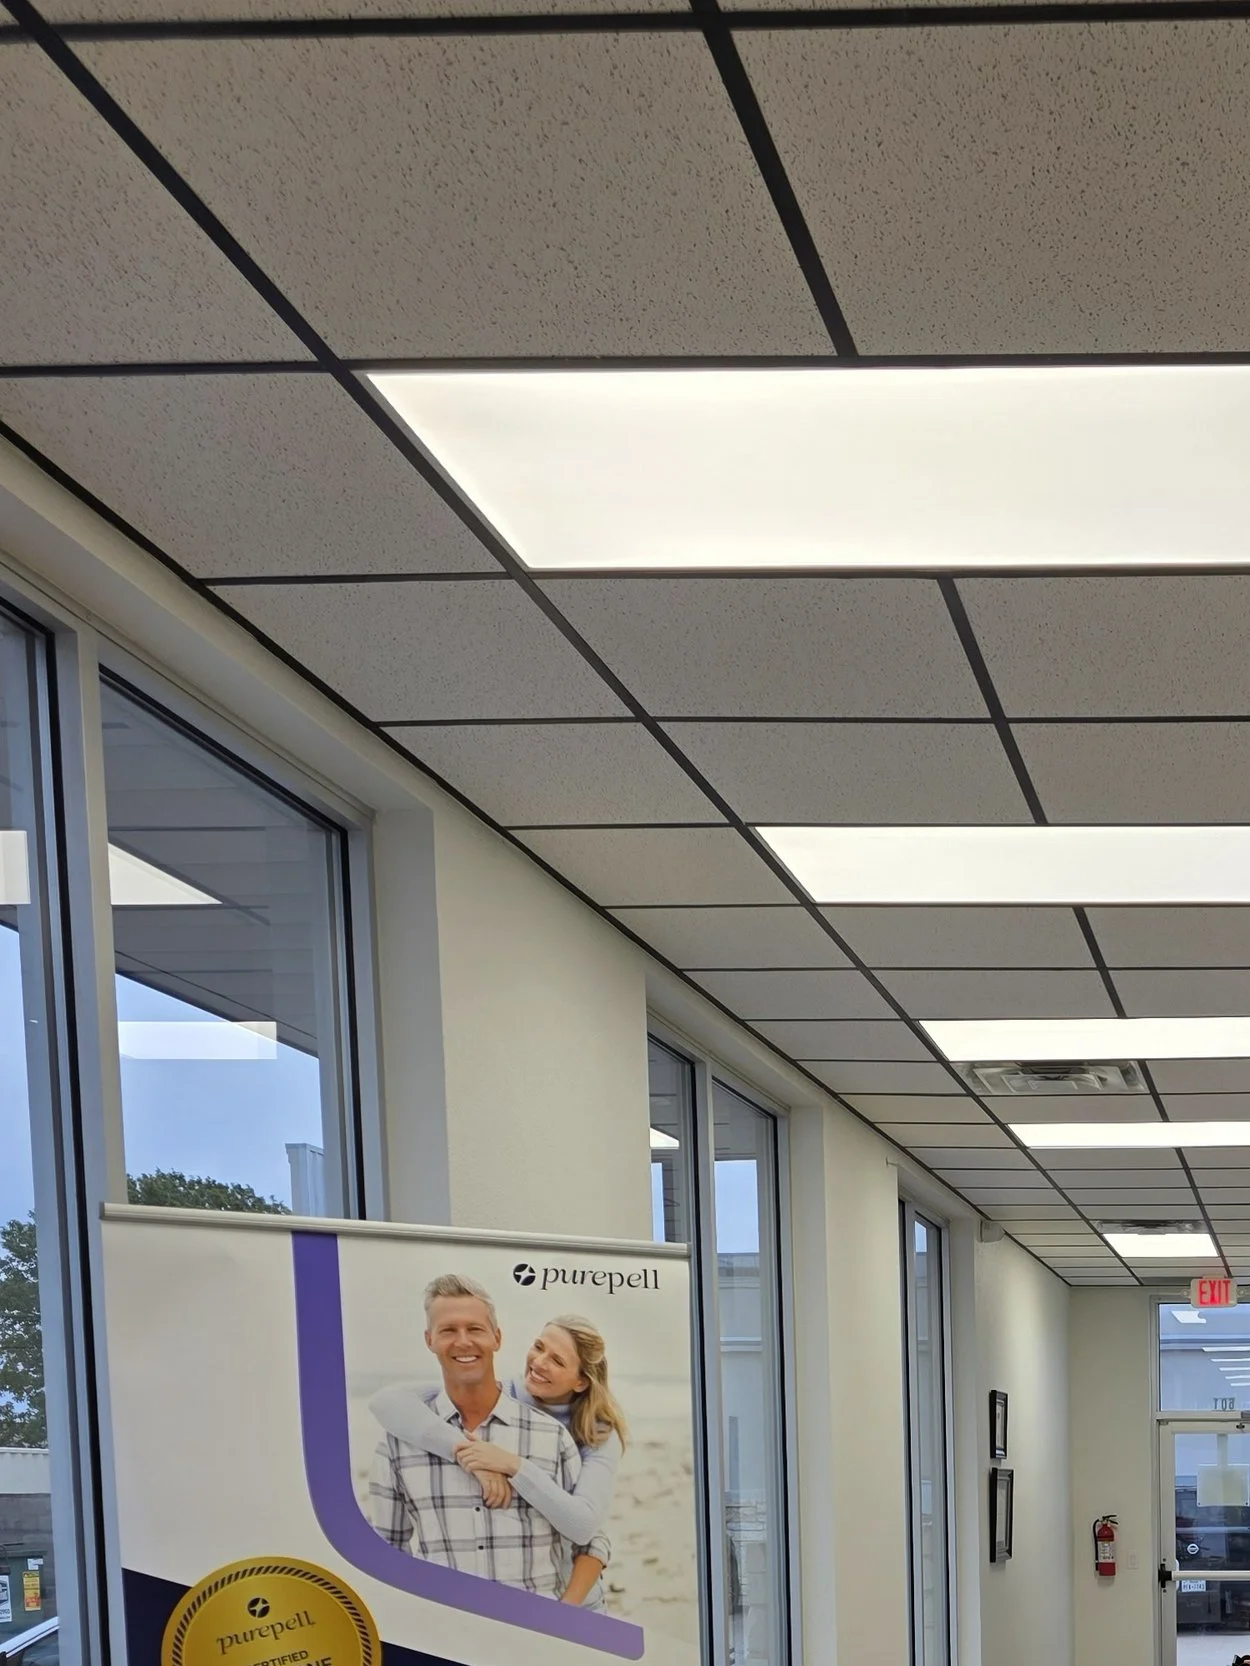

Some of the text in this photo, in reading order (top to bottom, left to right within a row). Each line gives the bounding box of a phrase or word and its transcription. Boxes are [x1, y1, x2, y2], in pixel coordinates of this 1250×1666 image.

[541, 1268, 659, 1294] purepell
[1199, 1280, 1231, 1305] EXIT
[216, 1610, 316, 1655] purepell
